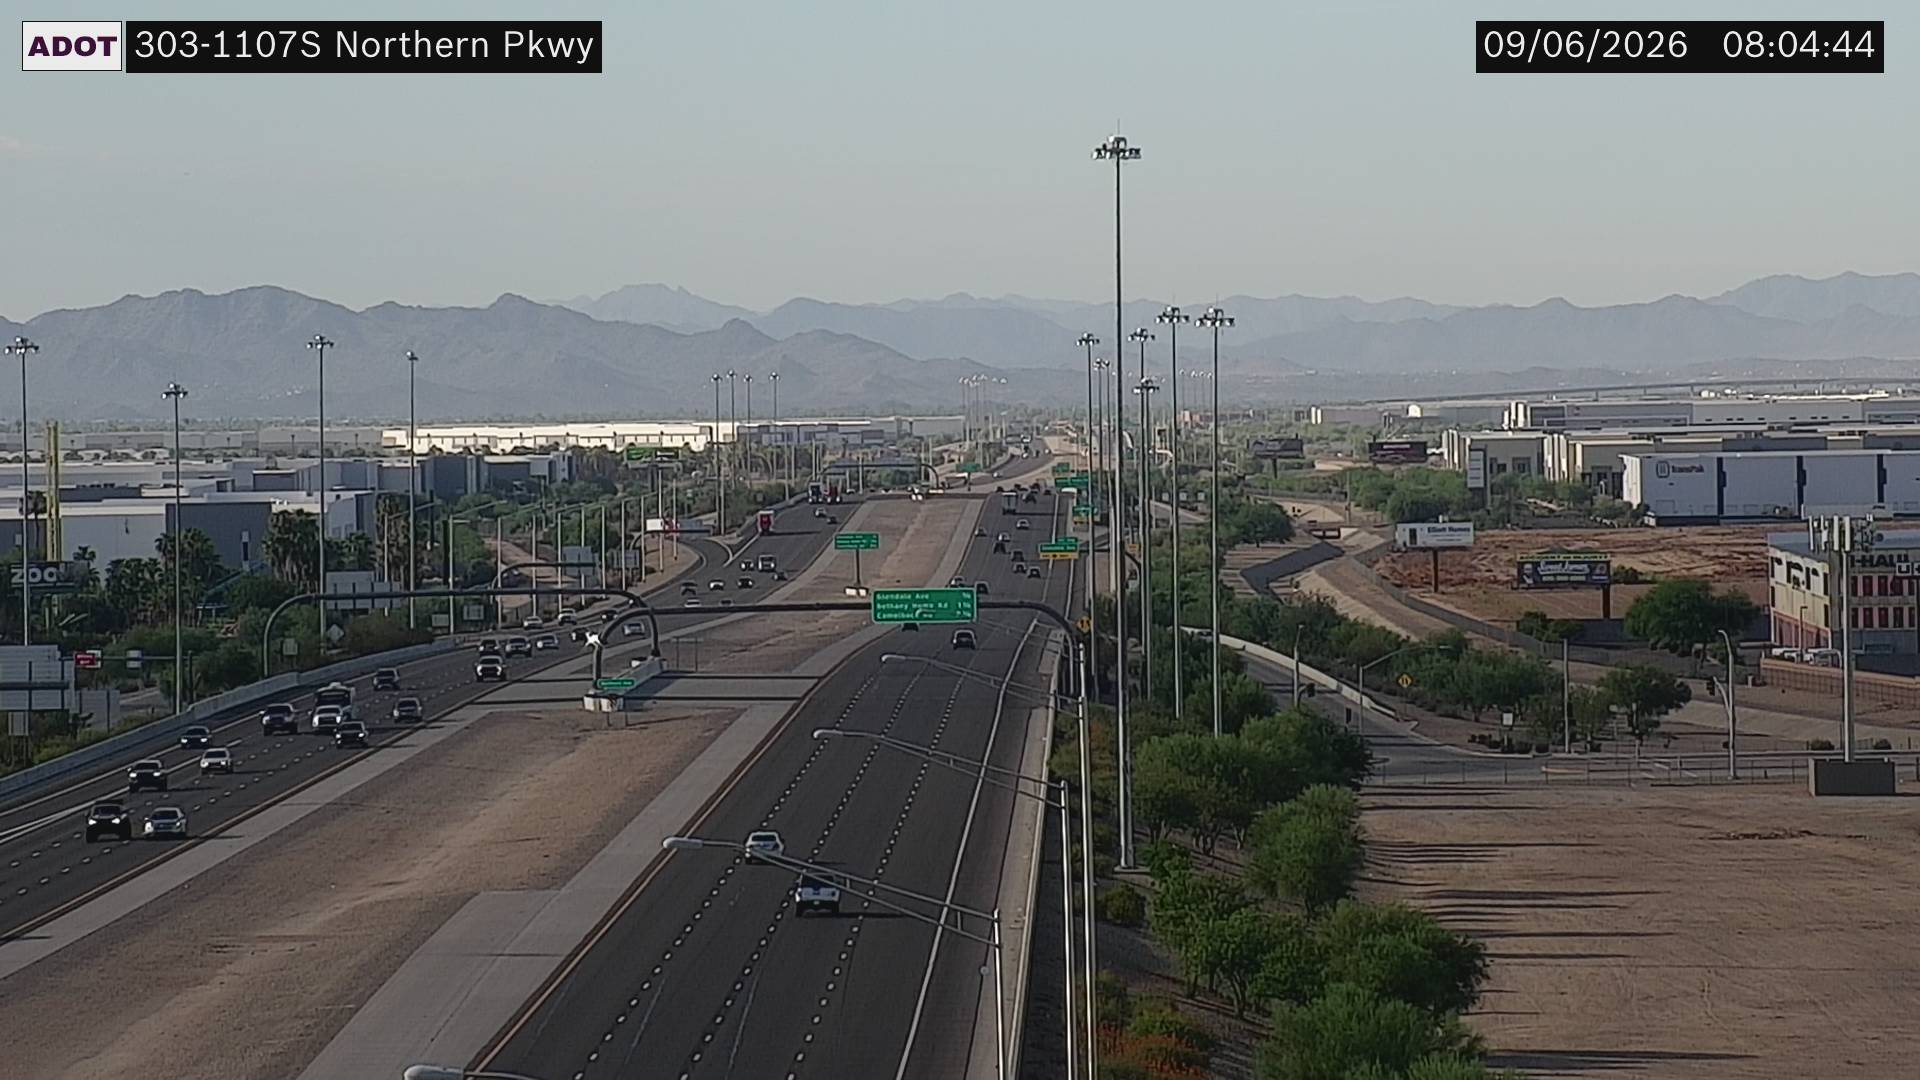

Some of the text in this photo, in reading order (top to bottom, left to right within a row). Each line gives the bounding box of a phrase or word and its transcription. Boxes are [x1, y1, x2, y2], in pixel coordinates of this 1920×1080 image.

[876, 592, 929, 600] Glendale Ave
[876, 602, 908, 610] Bethany
